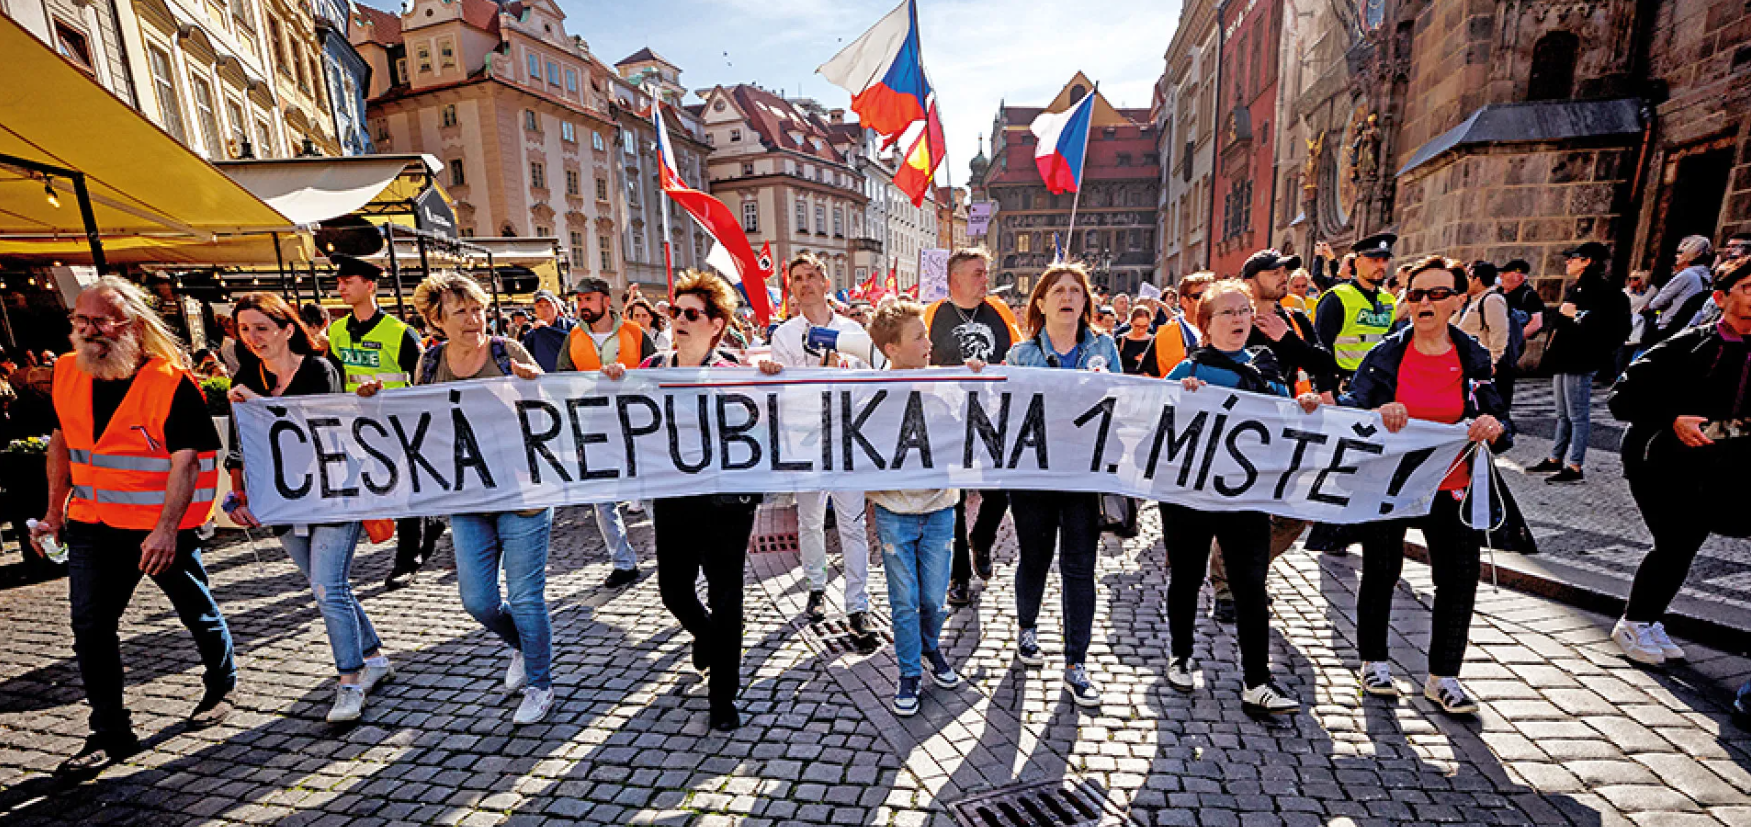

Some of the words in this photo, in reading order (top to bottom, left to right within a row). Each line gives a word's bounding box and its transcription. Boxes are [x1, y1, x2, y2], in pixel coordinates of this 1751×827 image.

[1358, 309, 1390, 326] POLIC
[340, 350, 380, 367] OLICE
[264, 388, 498, 501] ČESKÁ
[514, 389, 934, 484] REPUBLIKA
[963, 390, 1049, 471] NA
[1073, 396, 1119, 474] 1.
